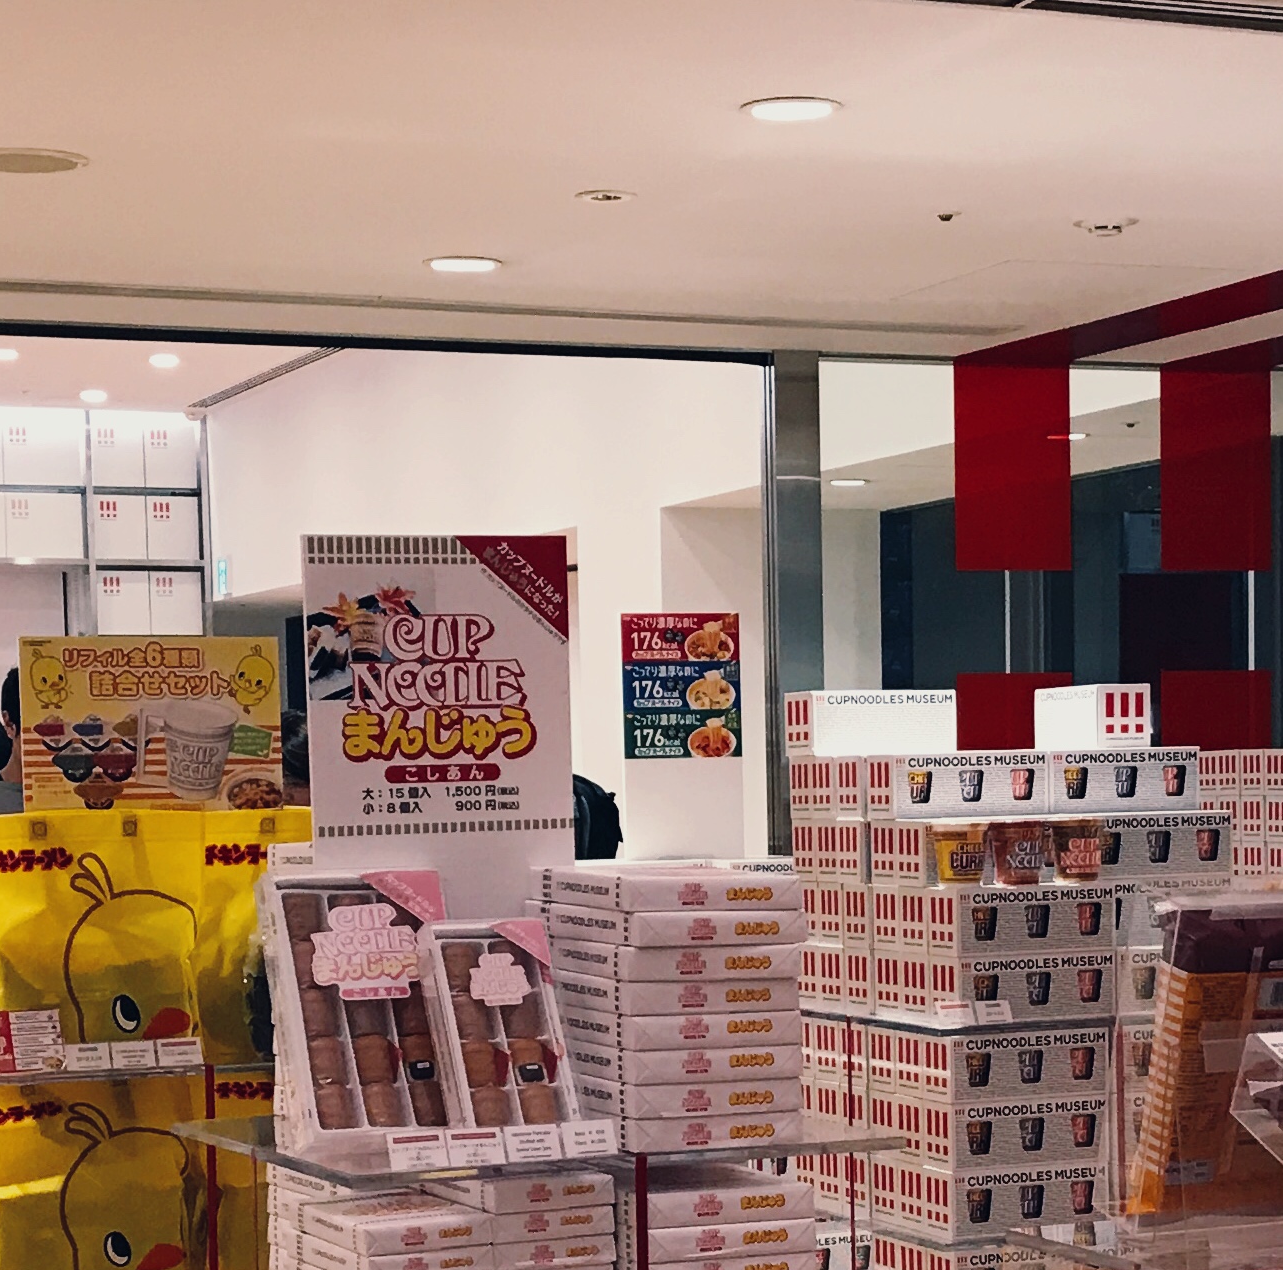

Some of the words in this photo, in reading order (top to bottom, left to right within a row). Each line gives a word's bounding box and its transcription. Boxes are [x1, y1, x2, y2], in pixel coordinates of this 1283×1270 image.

[383, 613, 496, 663] CUP
[827, 694, 904, 705] CUPNOODLES
[906, 693, 953, 704] MUSEUM
[342, 706, 538, 763] まんじゅう
[907, 756, 992, 768] CUPNOODLES
[994, 754, 1046, 766] MUSEUM
[1064, 752, 1146, 764] CUPNOODLES
[1148, 751, 1198, 763] MUSEUM
[404, 766, 485, 782] こしあん
[1106, 816, 1179, 829] UPNOODLES
[1181, 814, 1231, 827] MUSEUM
[973, 891, 1059, 905] CUPNOODLES
[1061, 888, 1113, 900] MUSEUM
[973, 958, 1059, 973] CUPNOODLES
[1061, 954, 1113, 969] MUSEUM
[966, 1036, 1052, 1051] CUPNOODLES
[1053, 1032, 1106, 1046] MUSEUM
[967, 1103, 1053, 1119] CUPNOODLES
[967, 1172, 1053, 1187] CUPNOODLES
